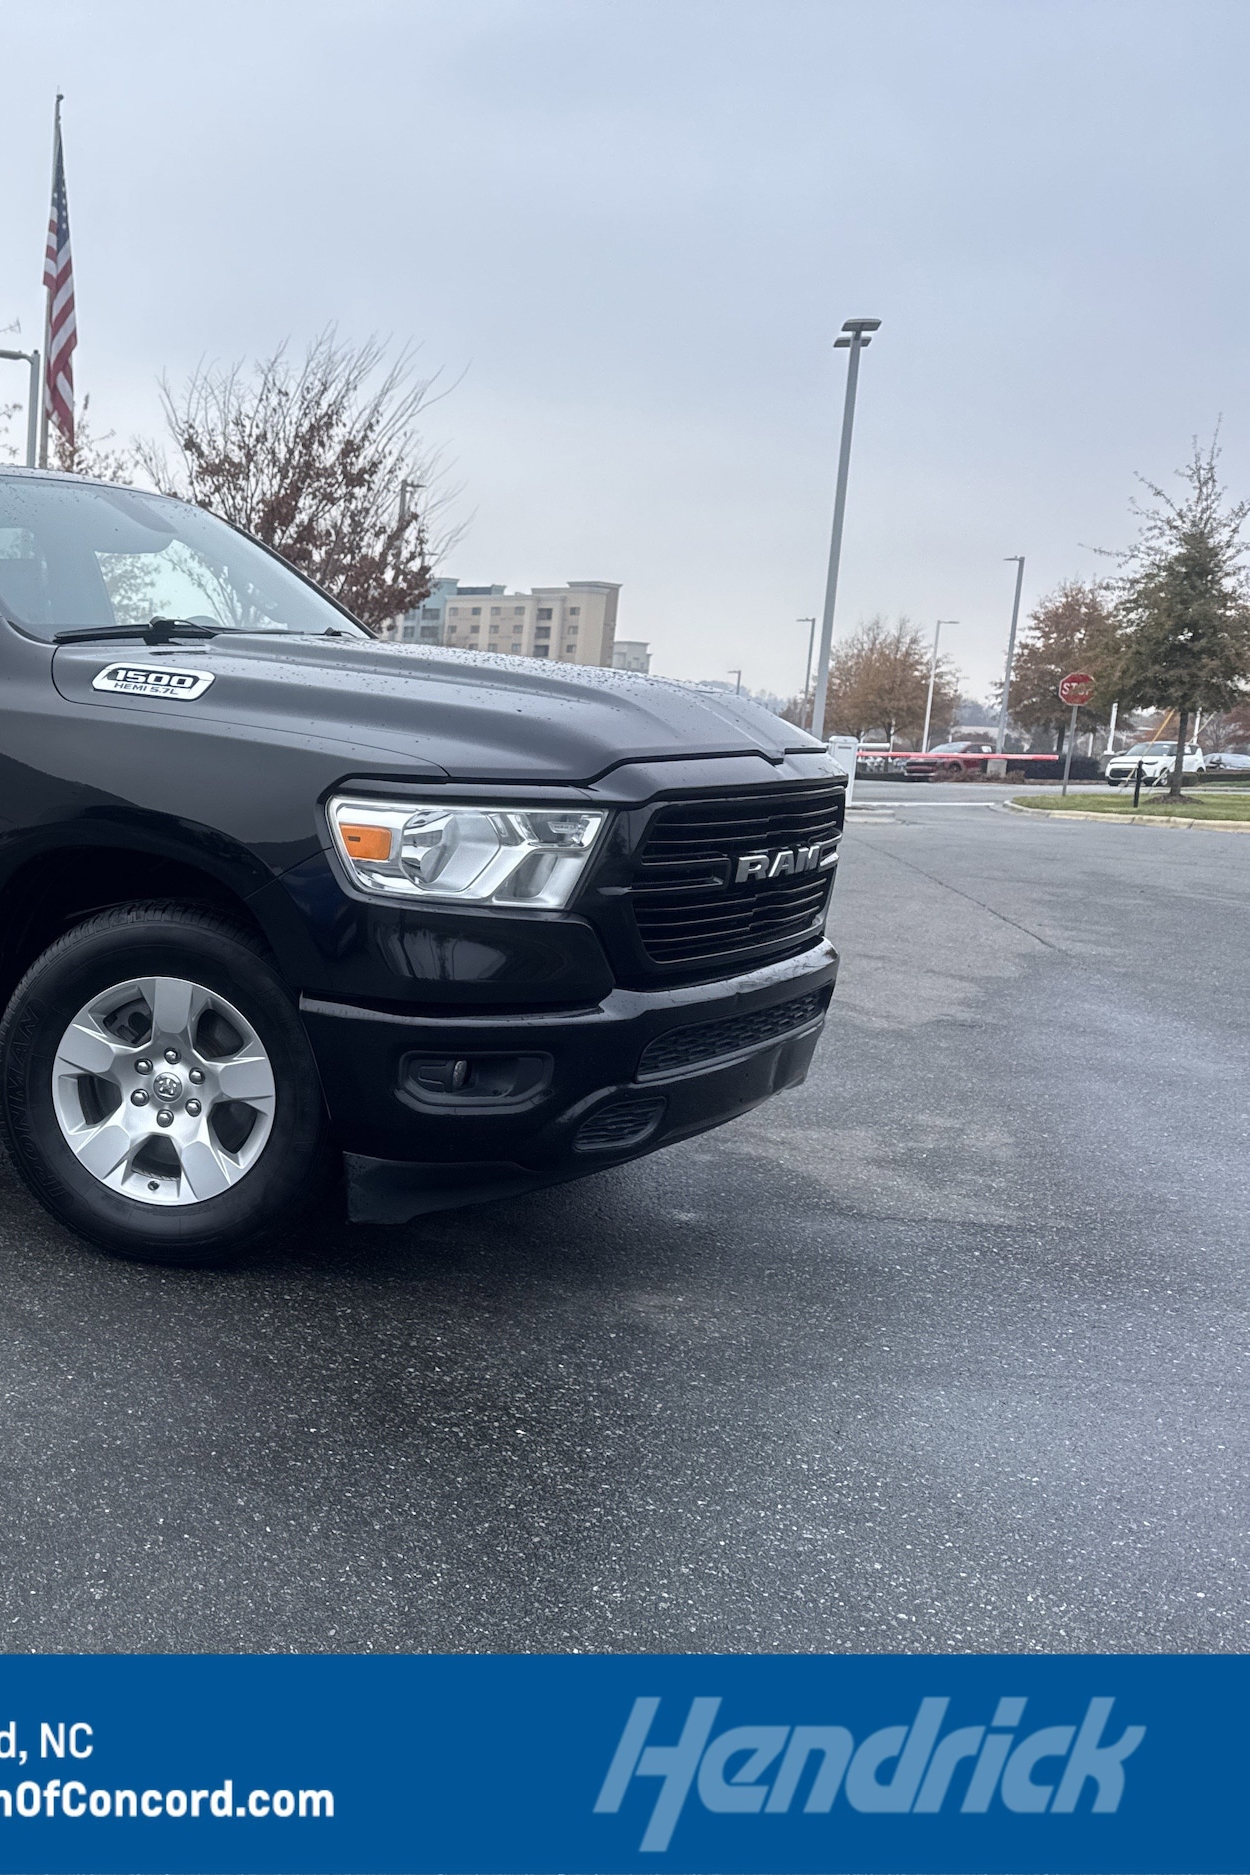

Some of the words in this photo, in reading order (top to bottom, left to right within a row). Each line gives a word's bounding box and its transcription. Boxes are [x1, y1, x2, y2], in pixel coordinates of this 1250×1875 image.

[115, 668, 194, 689] 1500
[113, 682, 147, 692] HEMI
[149, 686, 179, 695] 5.7L
[1062, 682, 1092, 696] ST
[734, 845, 820, 884] RAM
